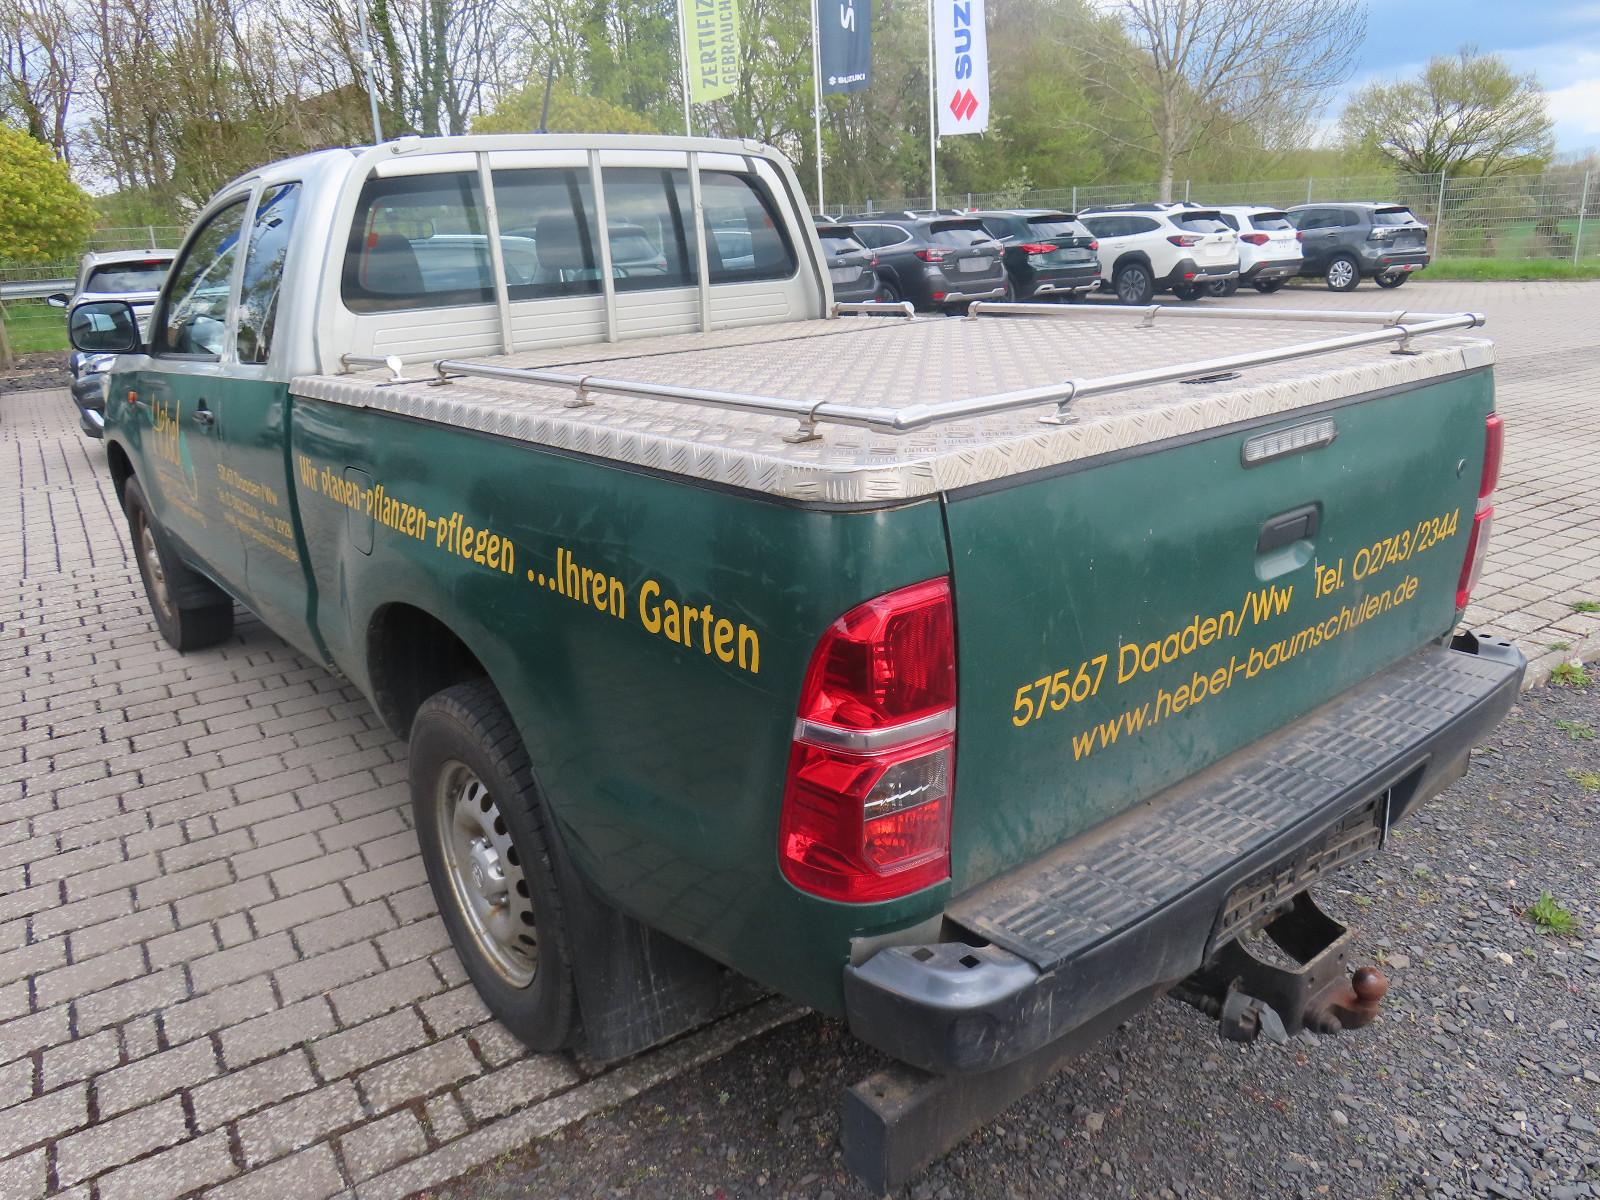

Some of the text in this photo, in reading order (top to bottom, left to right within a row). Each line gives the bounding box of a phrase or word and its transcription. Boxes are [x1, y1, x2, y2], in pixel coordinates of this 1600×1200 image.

[695, 0, 719, 89] ZERTIFIZ
[837, 73, 866, 84] SUZUKI
[953, 0, 973, 80] SUZ
[299, 455, 319, 492] Wir
[321, 466, 516, 576] planen-pflanzen-pflegen
[639, 579, 762, 675] Garten
[1012, 507, 1460, 727] 57567 Daaden/Ww Tel. 02743/2344
[1071, 575, 1419, 761] www.hebel-baumschulen.de
